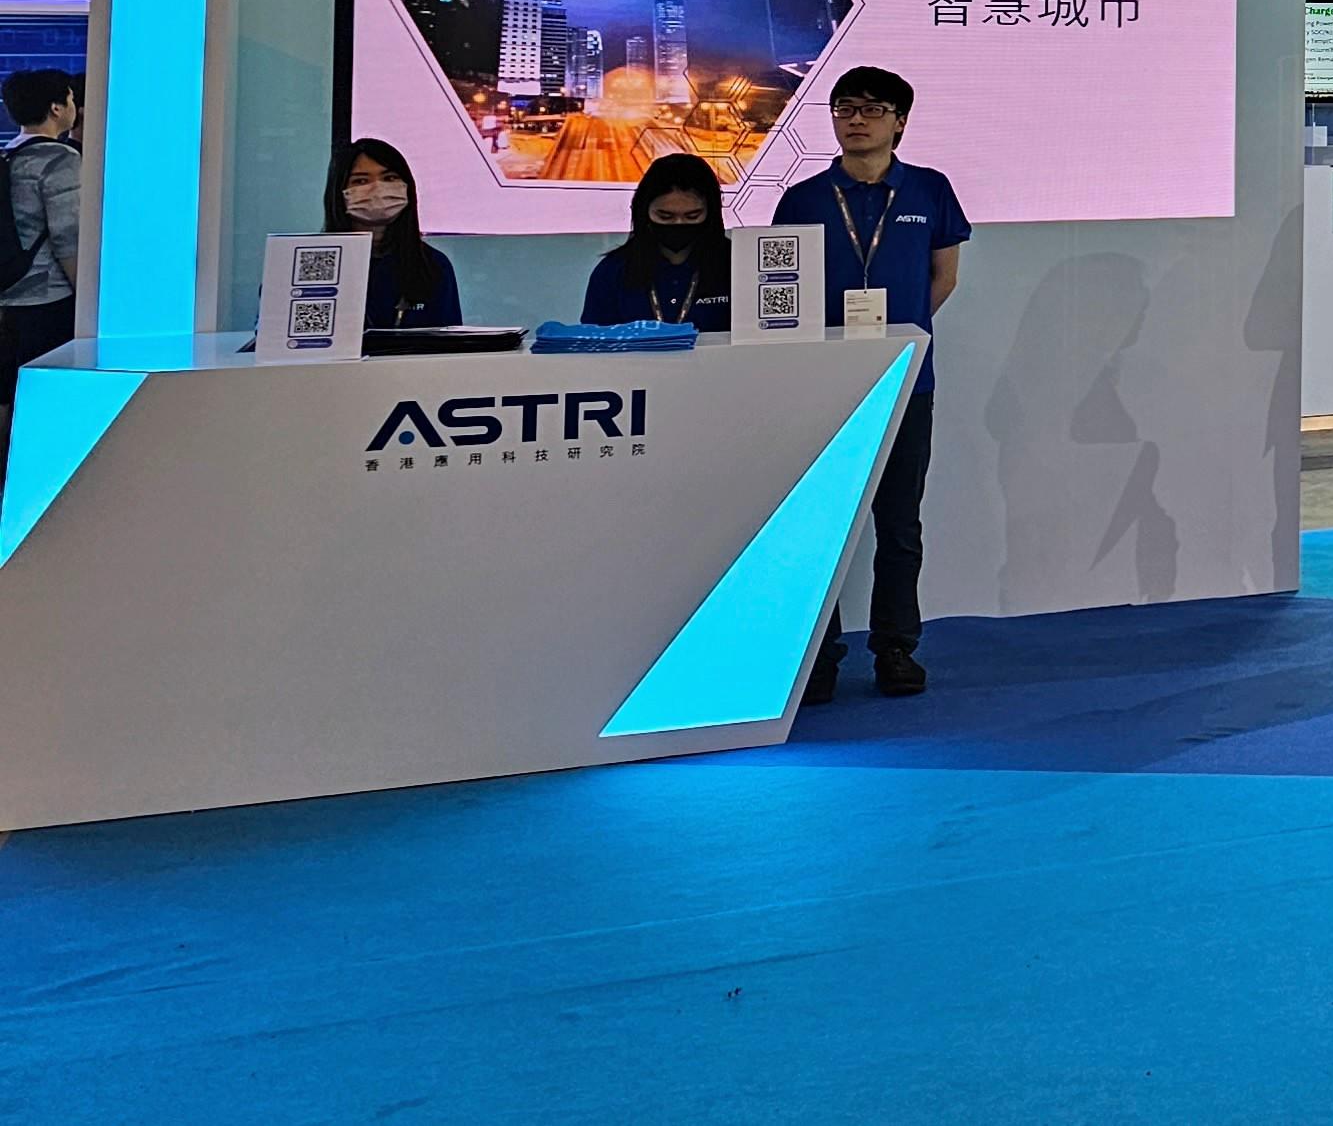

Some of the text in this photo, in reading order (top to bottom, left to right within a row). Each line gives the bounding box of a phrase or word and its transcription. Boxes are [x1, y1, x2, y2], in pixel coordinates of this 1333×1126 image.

[895, 214, 927, 224] ASTRI
[695, 295, 729, 305] ASTRI
[365, 388, 647, 452] ASTRI
[364, 441, 648, 473] 香港應用科技研究院
